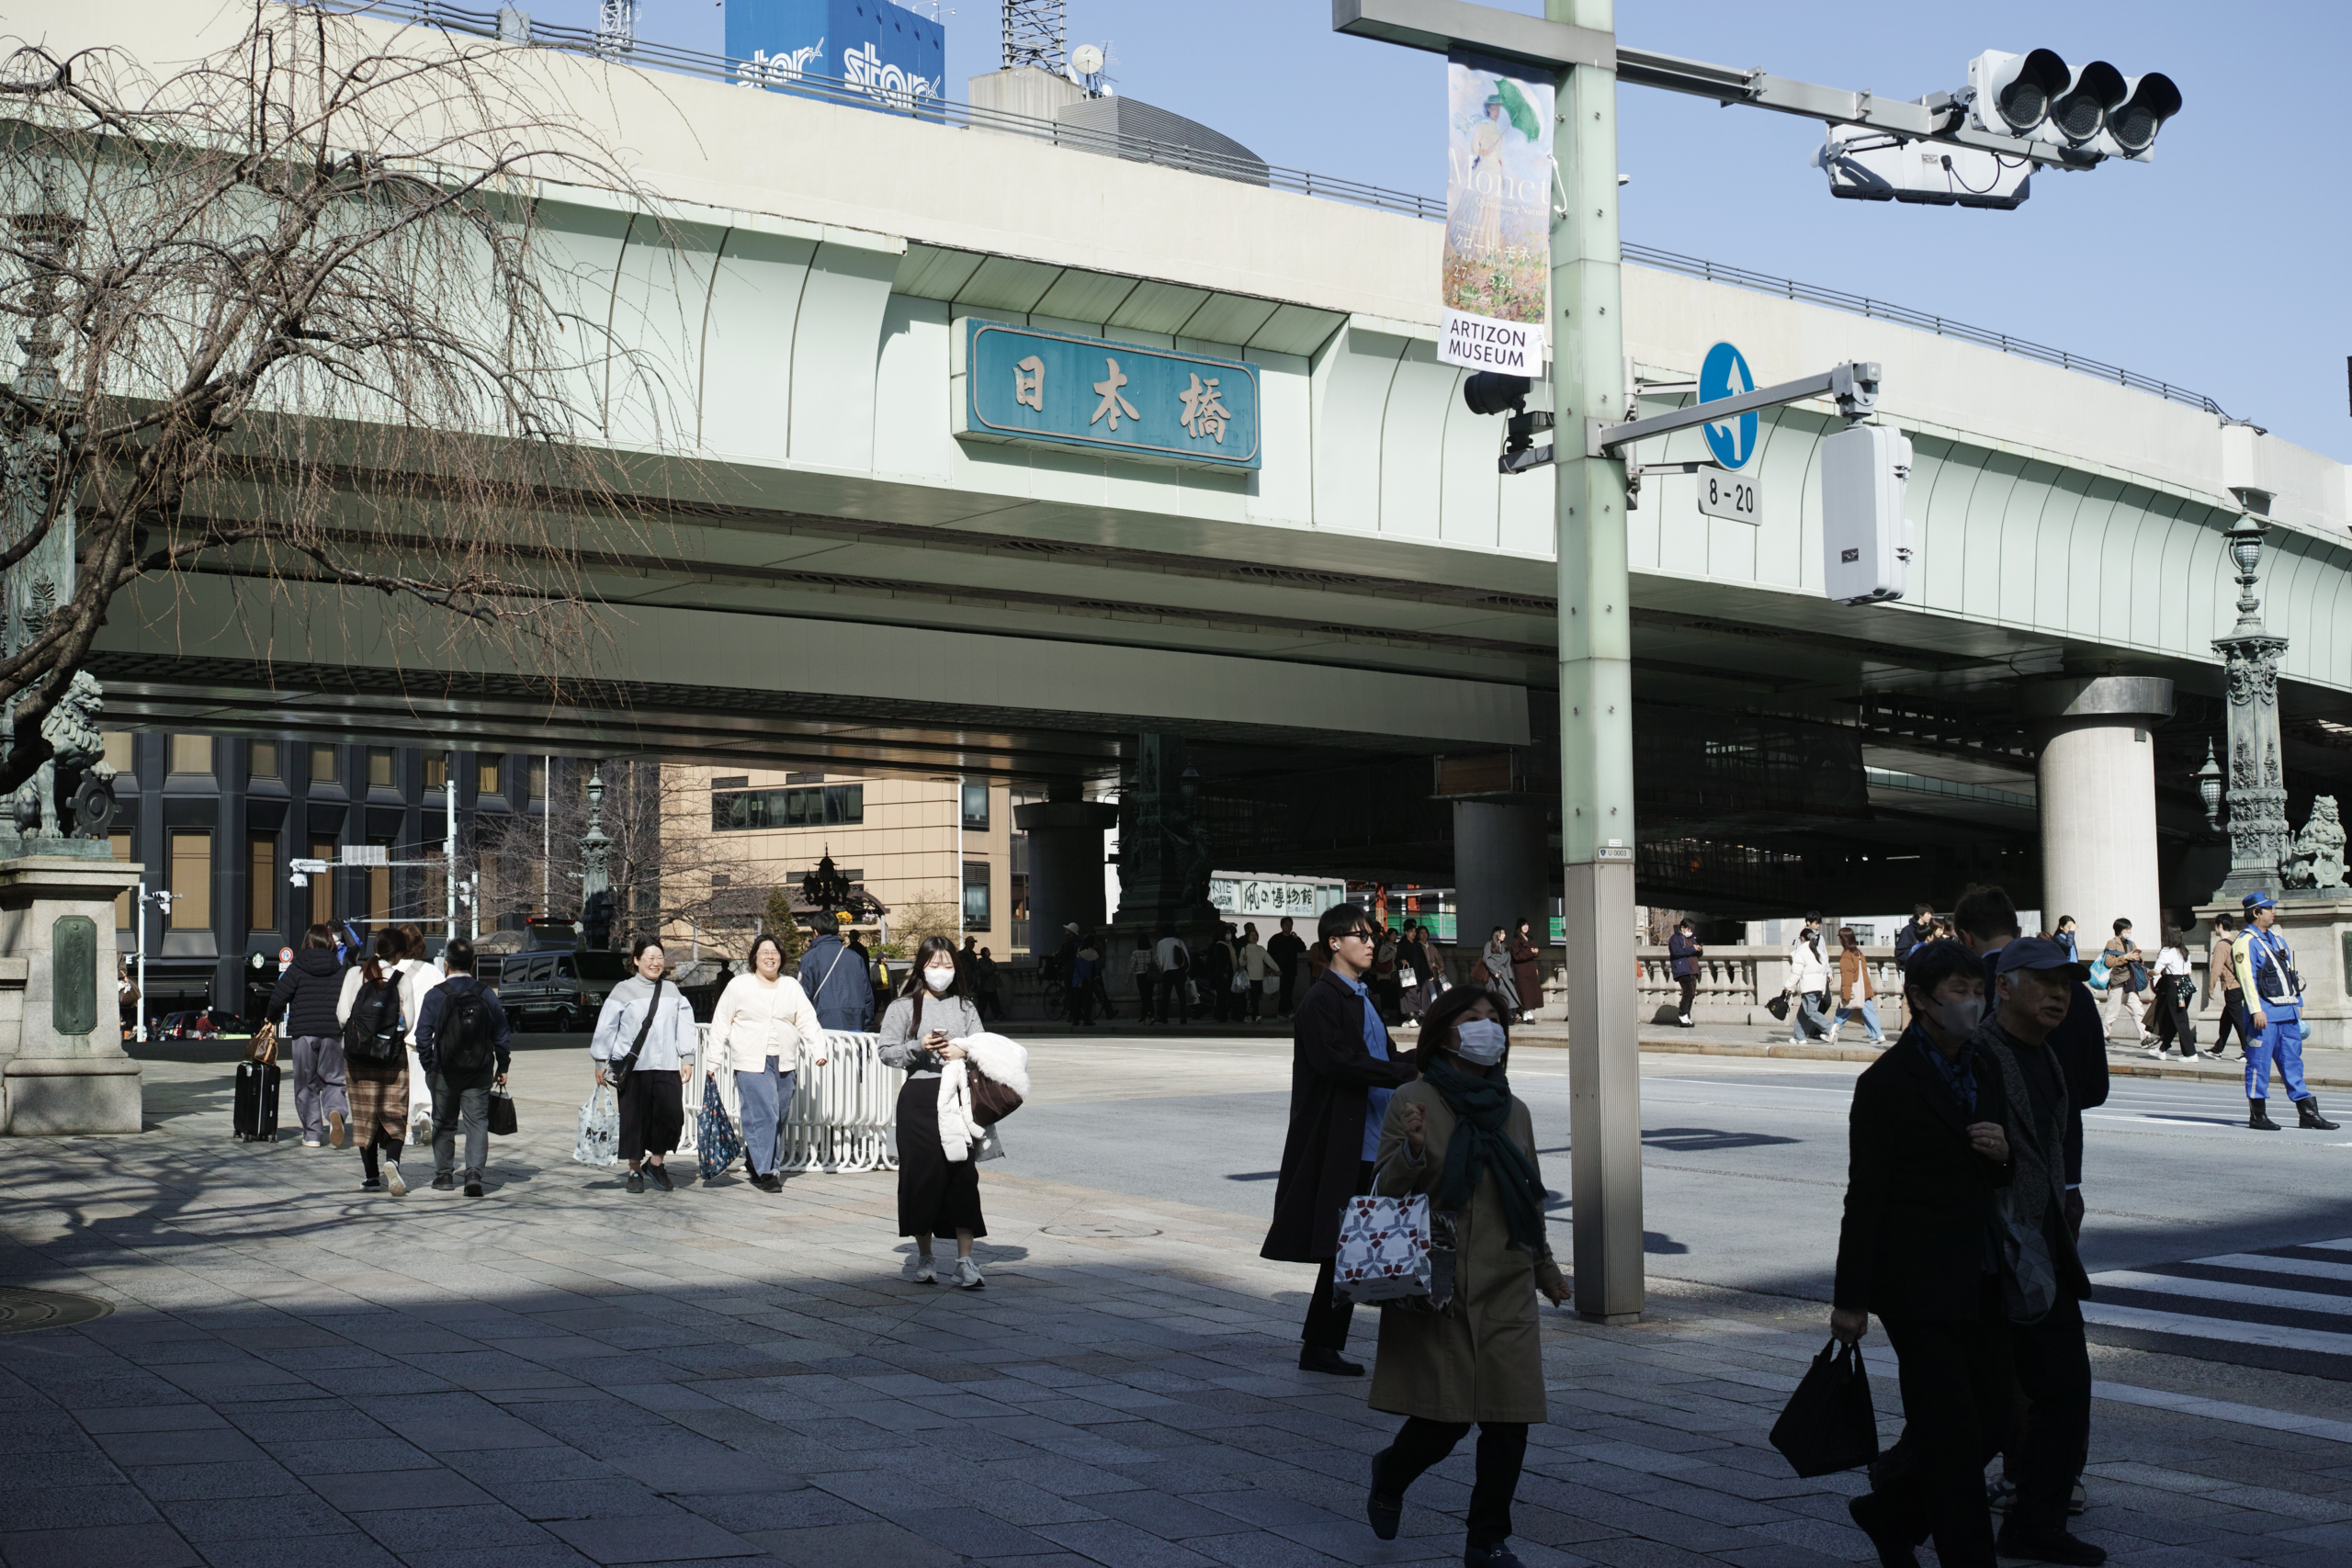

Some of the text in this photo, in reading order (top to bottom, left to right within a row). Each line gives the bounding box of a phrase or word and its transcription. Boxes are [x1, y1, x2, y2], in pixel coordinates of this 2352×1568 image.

[737, 43, 821, 89] star
[843, 41, 938, 108] star
[1448, 148, 1551, 205] Monet
[1476, 197, 1519, 215] Questioning
[1454, 233, 1531, 262] クロード・モネ
[1453, 265, 1467, 279] 2.7
[1488, 274, 1513, 289] 5.24
[1451, 319, 1525, 347] ARTIZON
[1449, 339, 1524, 367] MUSEUM
[1012, 355, 1231, 445] 日本橋
[1212, 879, 1232, 895] KITE
[1212, 895, 1233, 906] MUSEUM
